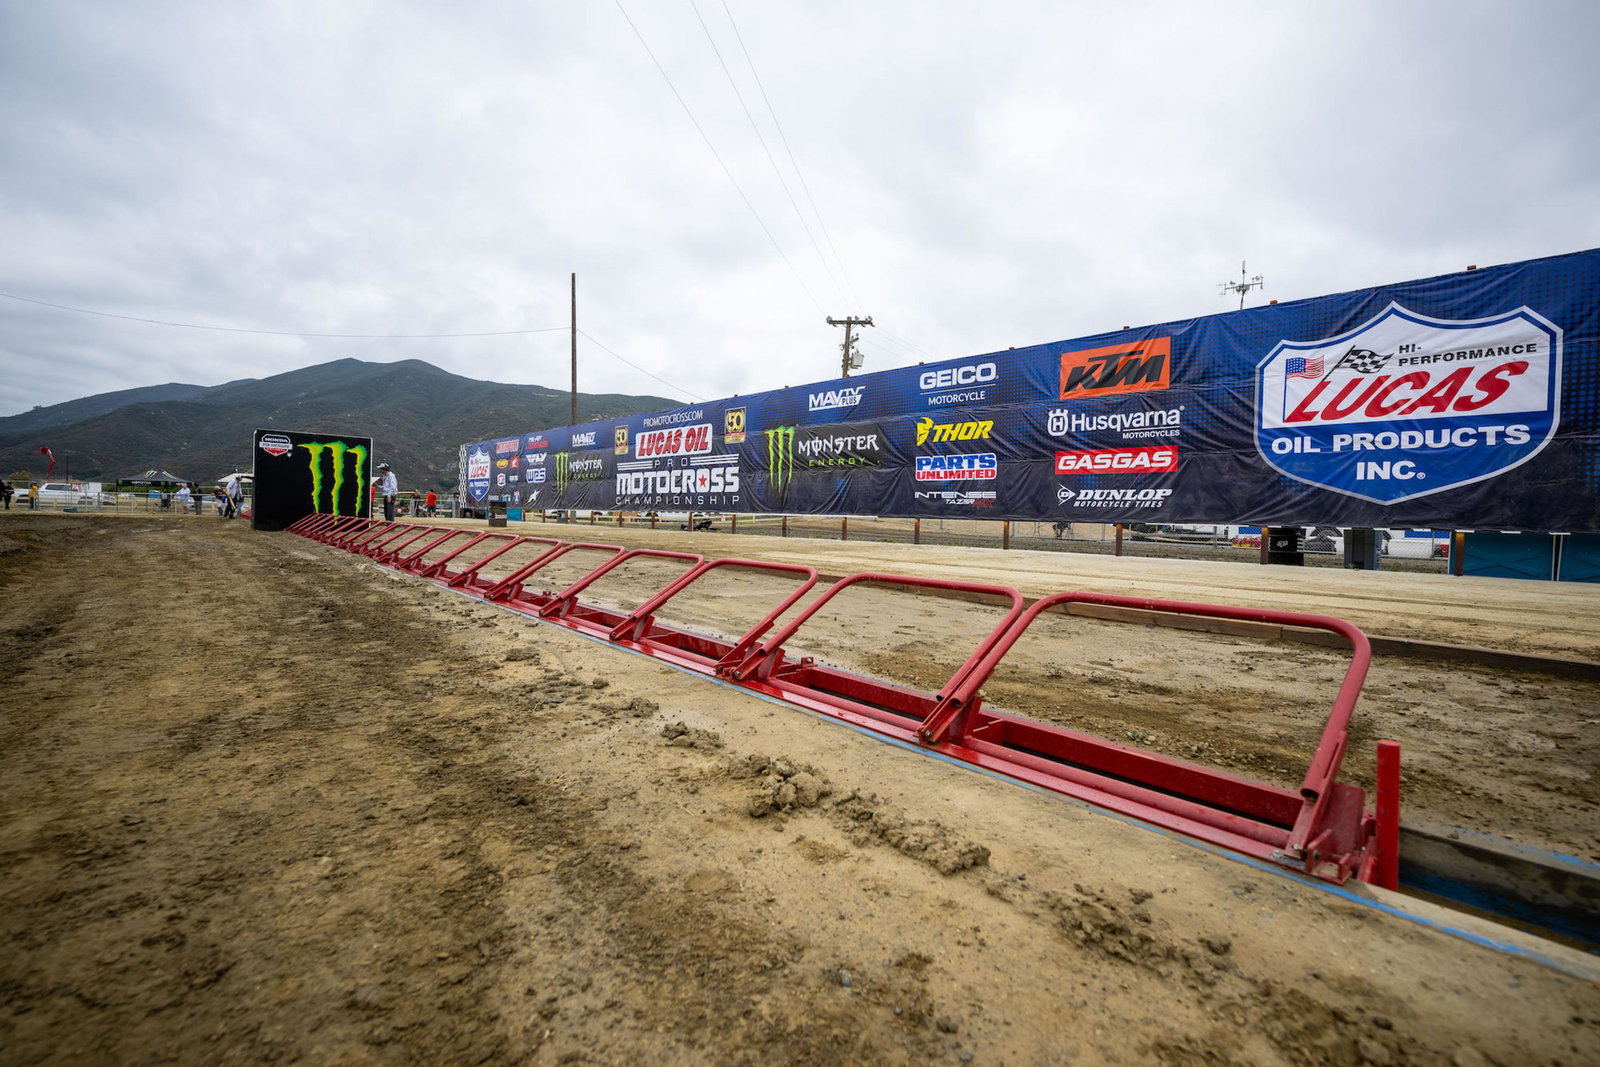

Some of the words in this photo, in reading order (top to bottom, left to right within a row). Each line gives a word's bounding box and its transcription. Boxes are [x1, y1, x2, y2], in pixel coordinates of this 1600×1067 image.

[1398, 343, 1537, 367] PERFORMANCE
[1399, 343, 1421, 354] HI-
[920, 363, 997, 389] GEICO
[1063, 349, 1166, 393] KTM
[841, 396, 857, 405] PLUS
[928, 391, 985, 405] MOTORCYCLE
[1284, 360, 1530, 424] LUCAS
[727, 410, 744, 431] 50
[1071, 408, 1180, 432] Husqvarna
[932, 420, 995, 443] THOR
[1122, 429, 1180, 439] MOTORCYCLES
[1271, 436, 1321, 455] OIL
[1332, 424, 1531, 453] PRODUCTS
[638, 429, 683, 456] LUCAS
[684, 426, 709, 453] OIL
[798, 433, 880, 456] MONSTER
[569, 459, 603, 472] MONSTER
[654, 458, 688, 468] PRO
[808, 457, 866, 467] ENERGY
[916, 453, 997, 471] PARTS
[1058, 451, 1173, 470] GASGAS
[616, 467, 740, 495] MOTOCROSS
[916, 468, 997, 481] UNLIMITED
[615, 496, 740, 505] CHAMPIONSHIP
[914, 491, 997, 499] INTENSE
[1076, 488, 1173, 501] DUNLOP
[1073, 500, 1130, 508] MOTORCYCLE
[1135, 500, 1163, 508] TIRES
